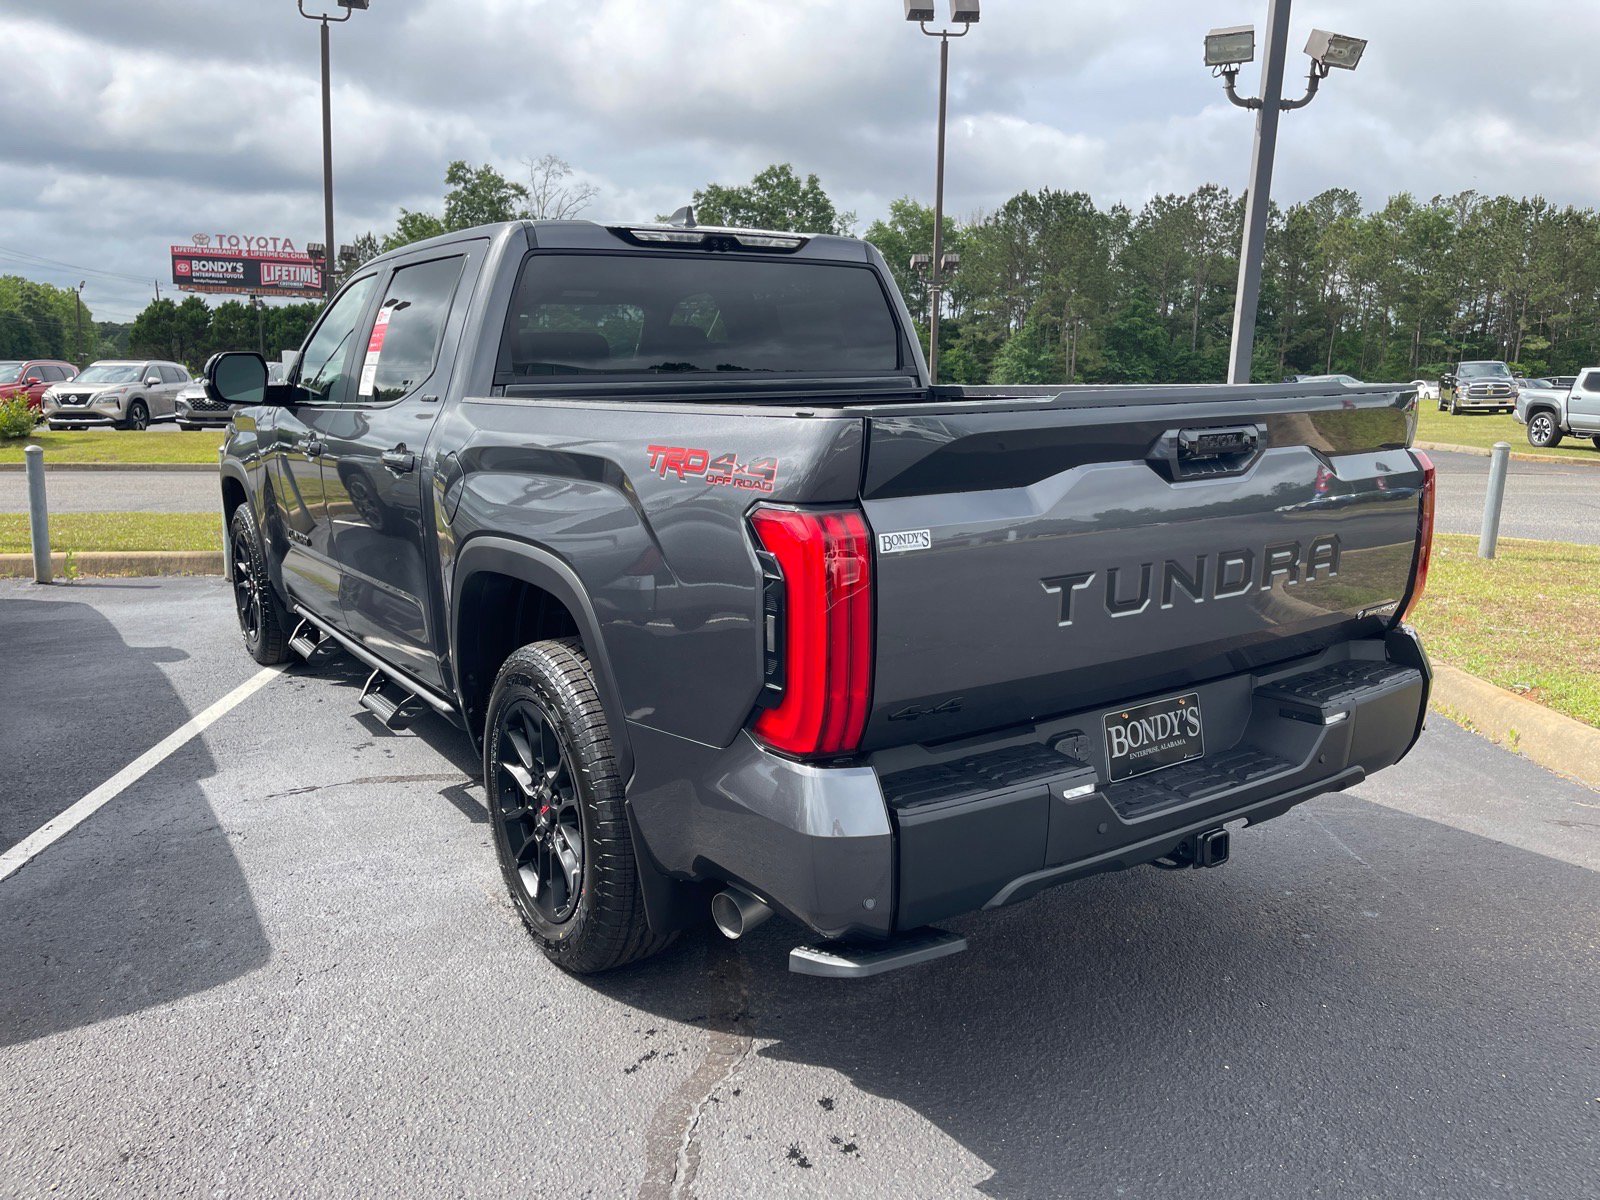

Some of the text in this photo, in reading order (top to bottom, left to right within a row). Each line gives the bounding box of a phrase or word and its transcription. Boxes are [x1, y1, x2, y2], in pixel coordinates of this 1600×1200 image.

[215, 233, 295, 252] TOYOTA
[250, 250, 278, 258] LIFETIME
[191, 260, 244, 273] BONDY'S
[263, 265, 319, 284] LIFETIME
[647, 445, 779, 483] TRD 4x4
[705, 474, 774, 493] OFF ROAD
[880, 531, 930, 552] BONDY'S
[1039, 533, 1341, 626] TUNDRA
[1107, 706, 1200, 758] BONDY'S
[1160, 738, 1186, 750] ALABAMA
